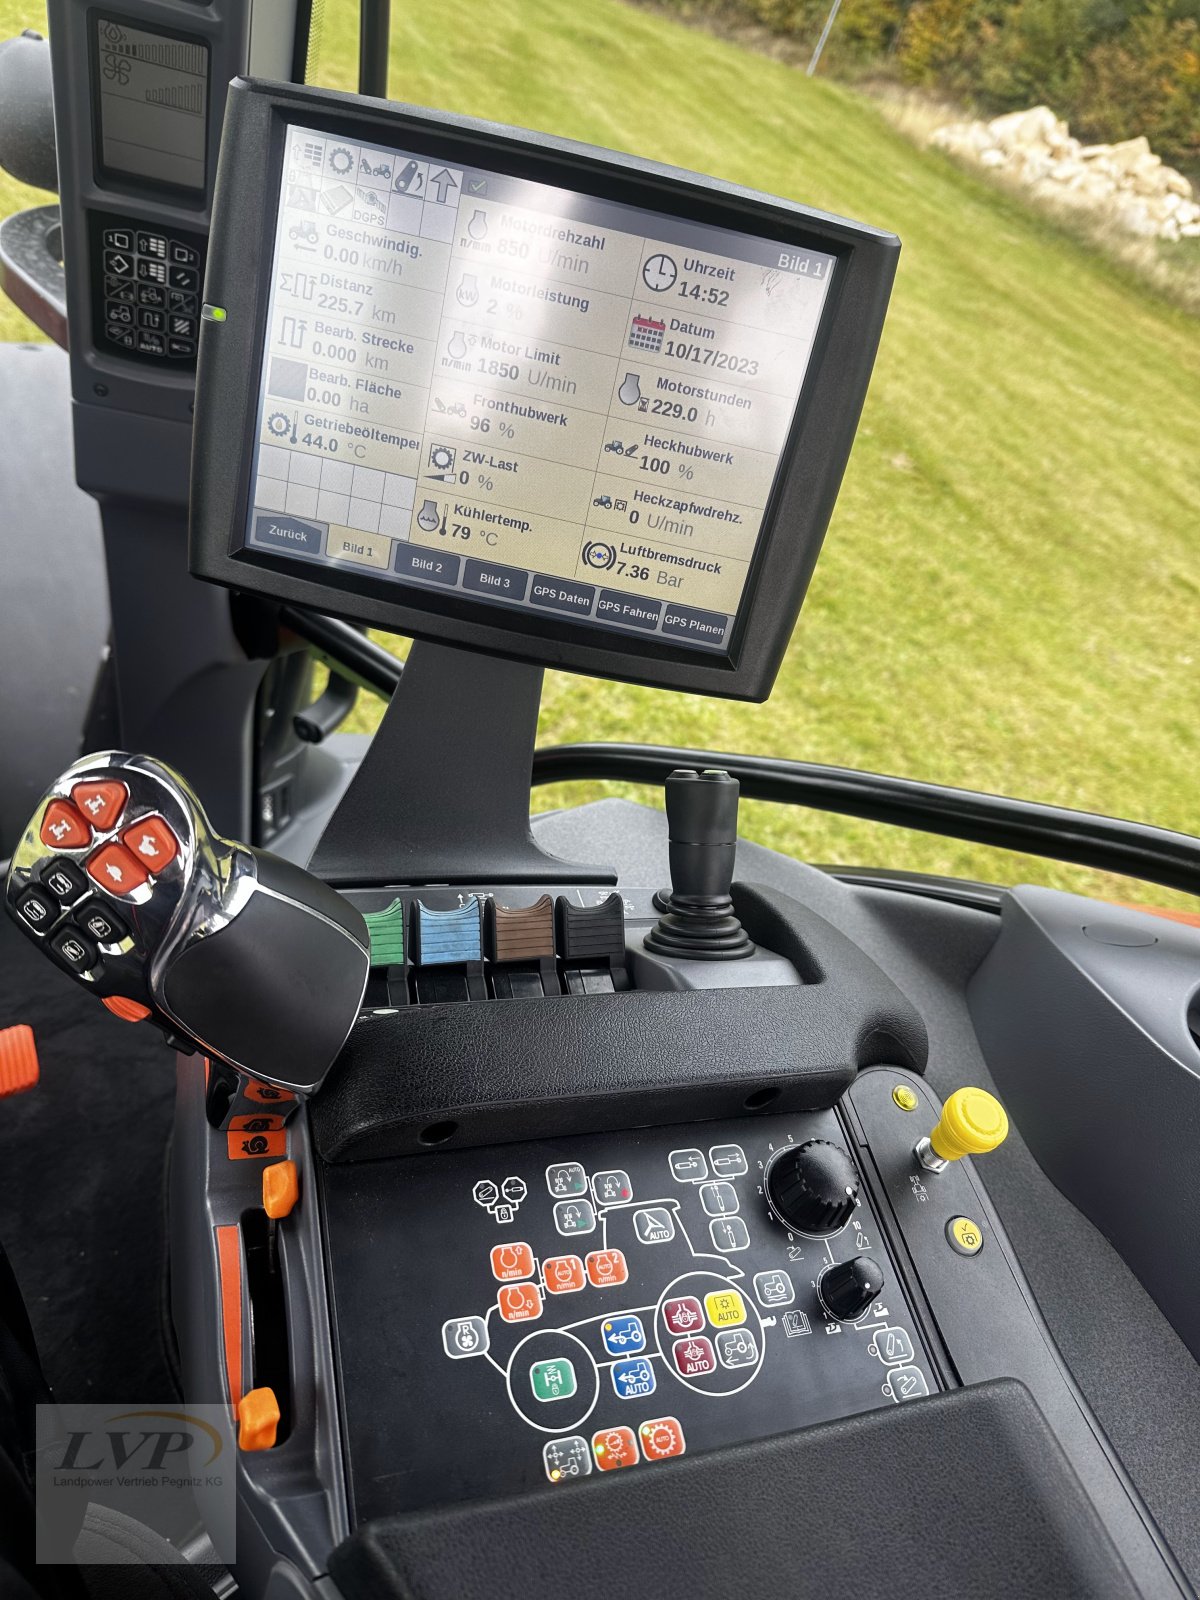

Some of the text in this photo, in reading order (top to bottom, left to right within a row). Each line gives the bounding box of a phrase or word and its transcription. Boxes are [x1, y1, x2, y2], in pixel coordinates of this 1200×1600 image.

[353, 208, 385, 226] DGPS
[326, 224, 423, 258] Geschwindig.
[500, 213, 606, 251] Motordrehzahl
[324, 244, 404, 276] 0.00 km/h
[497, 237, 590, 274] 850 U/min
[777, 253, 823, 277] Bild 1
[683, 257, 736, 282] Uhrzeit
[320, 272, 374, 296] Distanz
[490, 275, 590, 313] Motorleistung
[677, 281, 730, 307] 14:52
[318, 293, 397, 325] 225.7 km
[486, 299, 523, 321] 2 %
[314, 320, 415, 354] Bearb. Strecke
[669, 318, 716, 340] Datum
[312, 341, 389, 371] 0.000 km
[480, 335, 561, 366] Motor Limit
[664, 340, 760, 376] 10/17/2023
[309, 368, 402, 399] Bearb. Fläche
[477, 357, 577, 395] 1850 U/min
[306, 387, 370, 414] 0.00 ha
[656, 376, 752, 410] Motorstunden
[473, 393, 569, 427] Fronthubwerk
[651, 398, 716, 427] 229.0 h
[470, 415, 515, 439] 96 %
[302, 432, 339, 452] 44.0
[643, 433, 735, 465] Heckhubwerk
[462, 449, 519, 473] ZW-Last
[639, 455, 694, 481] 100 %
[459, 470, 494, 491] 0 %
[453, 503, 533, 534] Kühlertemp.
[633, 489, 743, 525] Heckzapfwdrehz.
[268, 523, 308, 543] Zurück
[451, 523, 471, 541] 79
[629, 509, 694, 538] 0 U/min
[342, 541, 373, 557] Bild 1
[619, 542, 722, 574] Luftbremsdruck
[411, 557, 443, 574] Bild 2
[616, 561, 685, 589] 7.36 Bar
[479, 572, 511, 588] Bild 3
[533, 585, 590, 607] GPS Daten
[598, 600, 659, 622] GPS Fahren
[664, 614, 725, 636] GPS Planen
[787, 1134, 794, 1143] 5
[757, 1160, 764, 1169] 3
[757, 1185, 764, 1194] 2
[768, 1211, 773, 1221] 1
[852, 1220, 862, 1230] 10
[649, 1230, 670, 1240] AUTO
[787, 1232, 794, 1242] 0
[570, 1258, 577, 1270] 1
[611, 1253, 620, 1264] 2
[501, 1269, 523, 1278] n/min
[597, 1275, 617, 1283] n/min
[556, 1281, 576, 1290] n/min
[508, 1309, 530, 1319] n/min
[718, 1310, 740, 1322] AUTO
[686, 1360, 709, 1373] AUTO
[625, 1383, 649, 1395] AUTO
